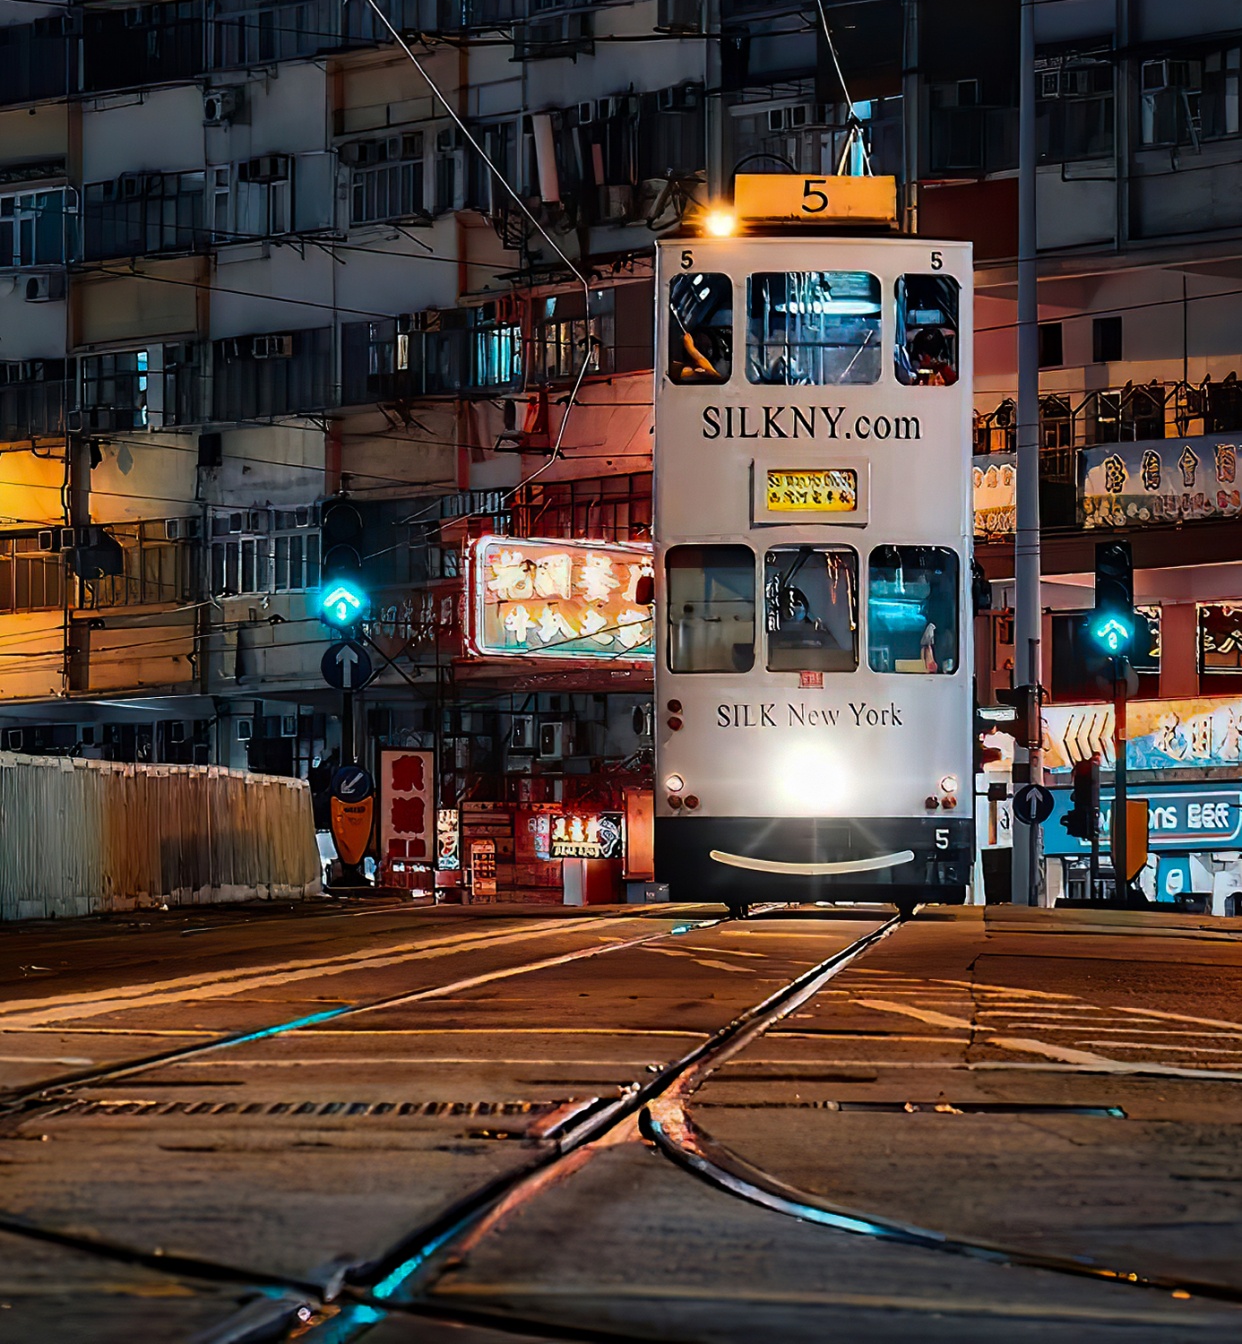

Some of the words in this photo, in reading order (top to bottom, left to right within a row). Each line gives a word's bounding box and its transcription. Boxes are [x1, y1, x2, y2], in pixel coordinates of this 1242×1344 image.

[802, 179, 829, 212] 5
[681, 250, 693, 270] 5
[931, 251, 943, 271] 5
[702, 405, 921, 440] SILKNY.com
[717, 703, 777, 728] SILK
[787, 703, 839, 727] New
[848, 702, 903, 727] York
[935, 828, 950, 850] 5
